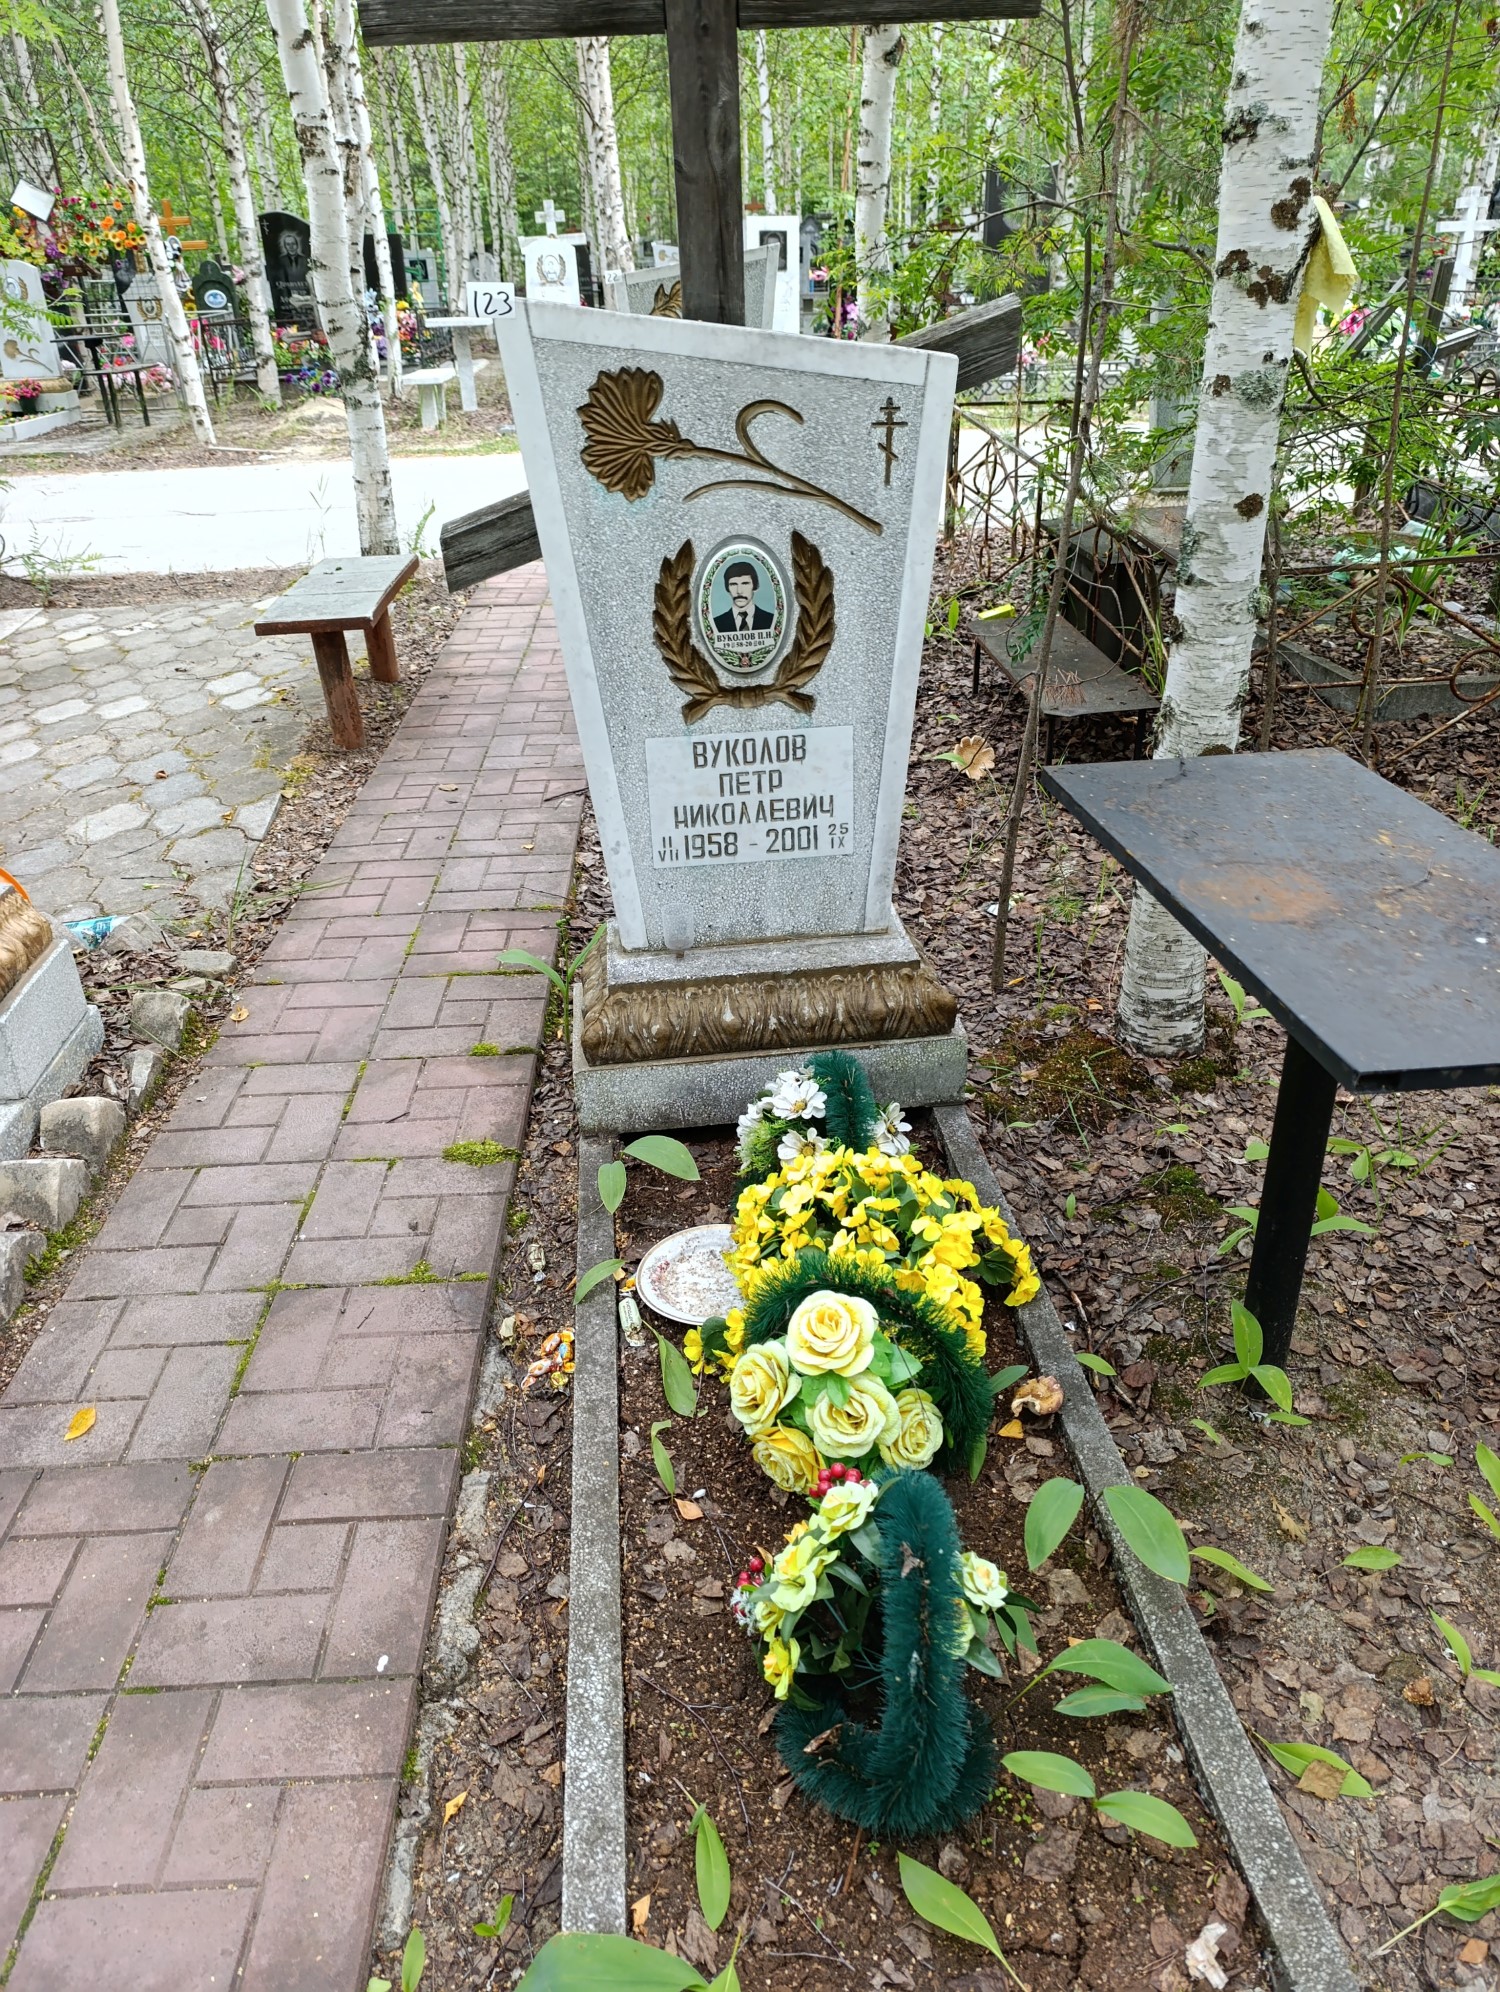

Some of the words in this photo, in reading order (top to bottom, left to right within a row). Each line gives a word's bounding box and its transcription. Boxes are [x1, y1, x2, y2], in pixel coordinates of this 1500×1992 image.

[474, 290, 513, 318] 123
[716, 632, 756, 643] ВУКОЛОВ
[757, 631, 774, 640] П.Н.
[692, 734, 807, 769] ВУКОЛОВ
[719, 769, 783, 797] ПЕТР
[673, 795, 834, 829] НИКОЛАЕВИЧ
[684, 831, 738, 860] 1958
[765, 825, 819, 853] 2001
[828, 822, 849, 836] 25
[830, 836, 846, 849] IX
